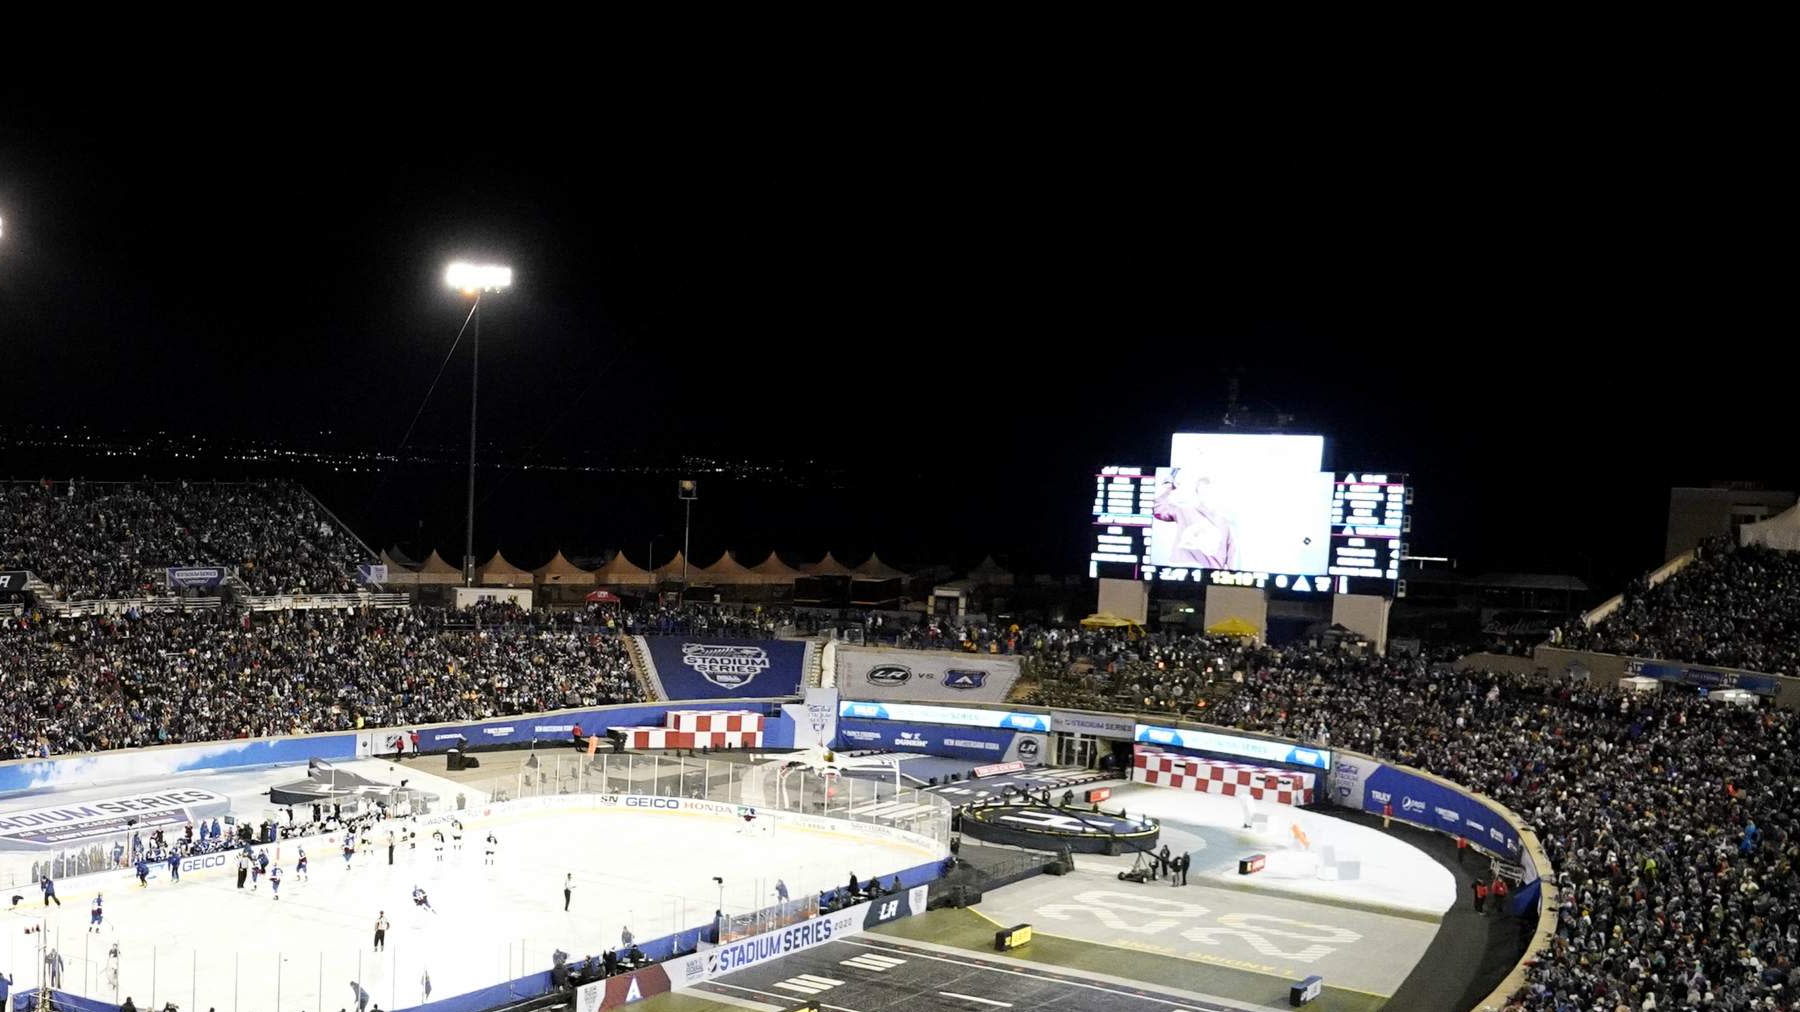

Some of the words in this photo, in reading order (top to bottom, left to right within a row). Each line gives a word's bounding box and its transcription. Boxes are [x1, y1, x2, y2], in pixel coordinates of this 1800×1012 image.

[686, 655, 769, 667] STADIUM
[698, 664, 758, 674] SERIES
[96, 790, 215, 814] SERIES
[625, 797, 679, 808] GEICO
[684, 801, 733, 814] HONDA
[182, 855, 227, 872] GEICO
[719, 942, 781, 972] STADIUM
[783, 919, 832, 951] SERIES
[834, 919, 853, 931] 2020
